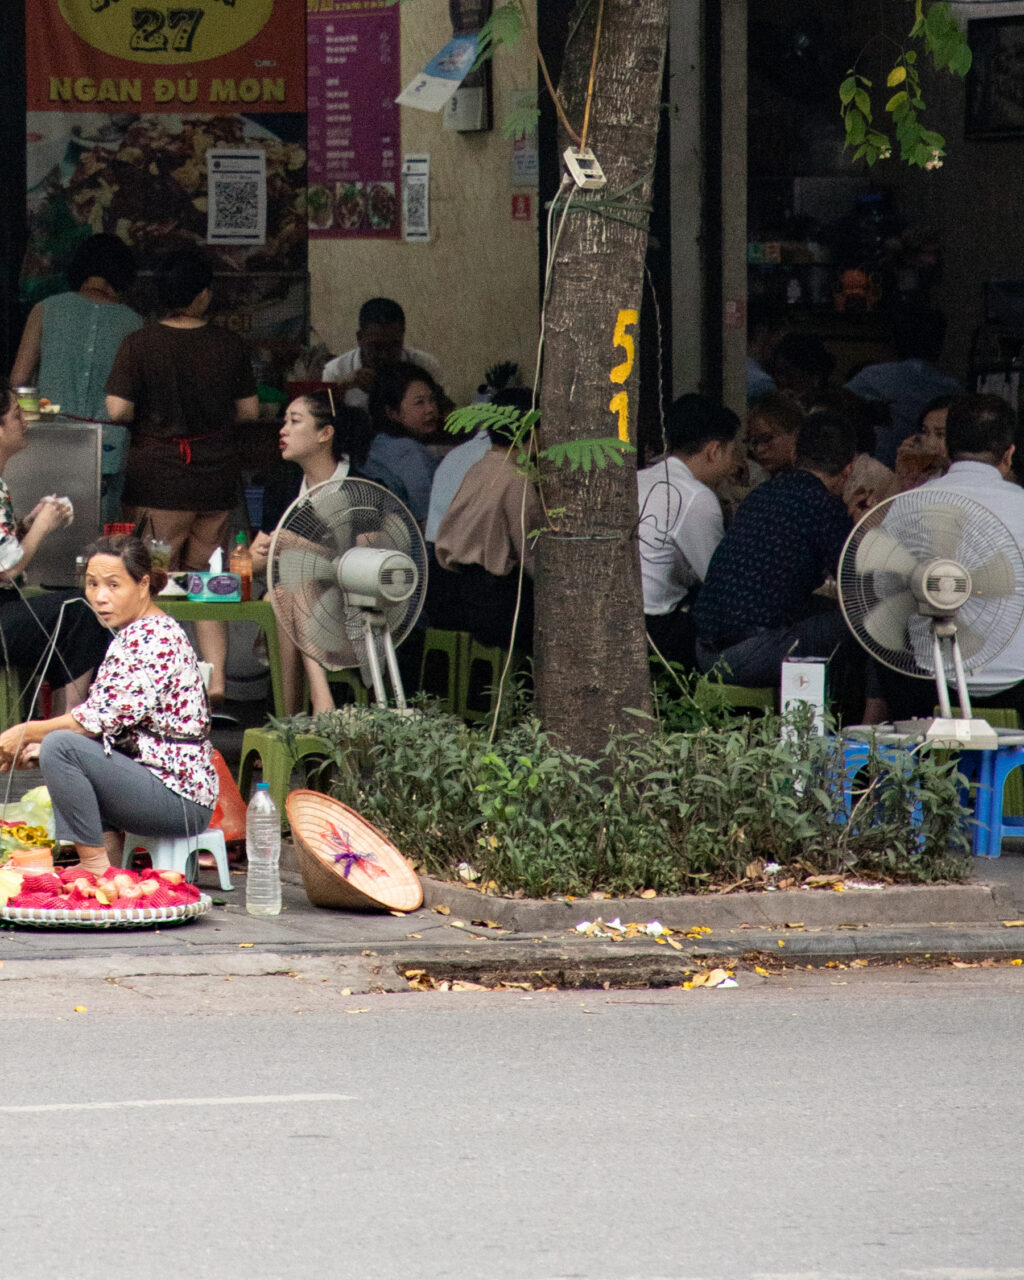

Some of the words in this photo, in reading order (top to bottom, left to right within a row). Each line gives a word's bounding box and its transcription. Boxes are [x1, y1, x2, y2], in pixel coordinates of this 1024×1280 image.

[129, 7, 204, 52] 27
[49, 76, 143, 105] NGAN
[153, 71, 199, 105] ĐỦ
